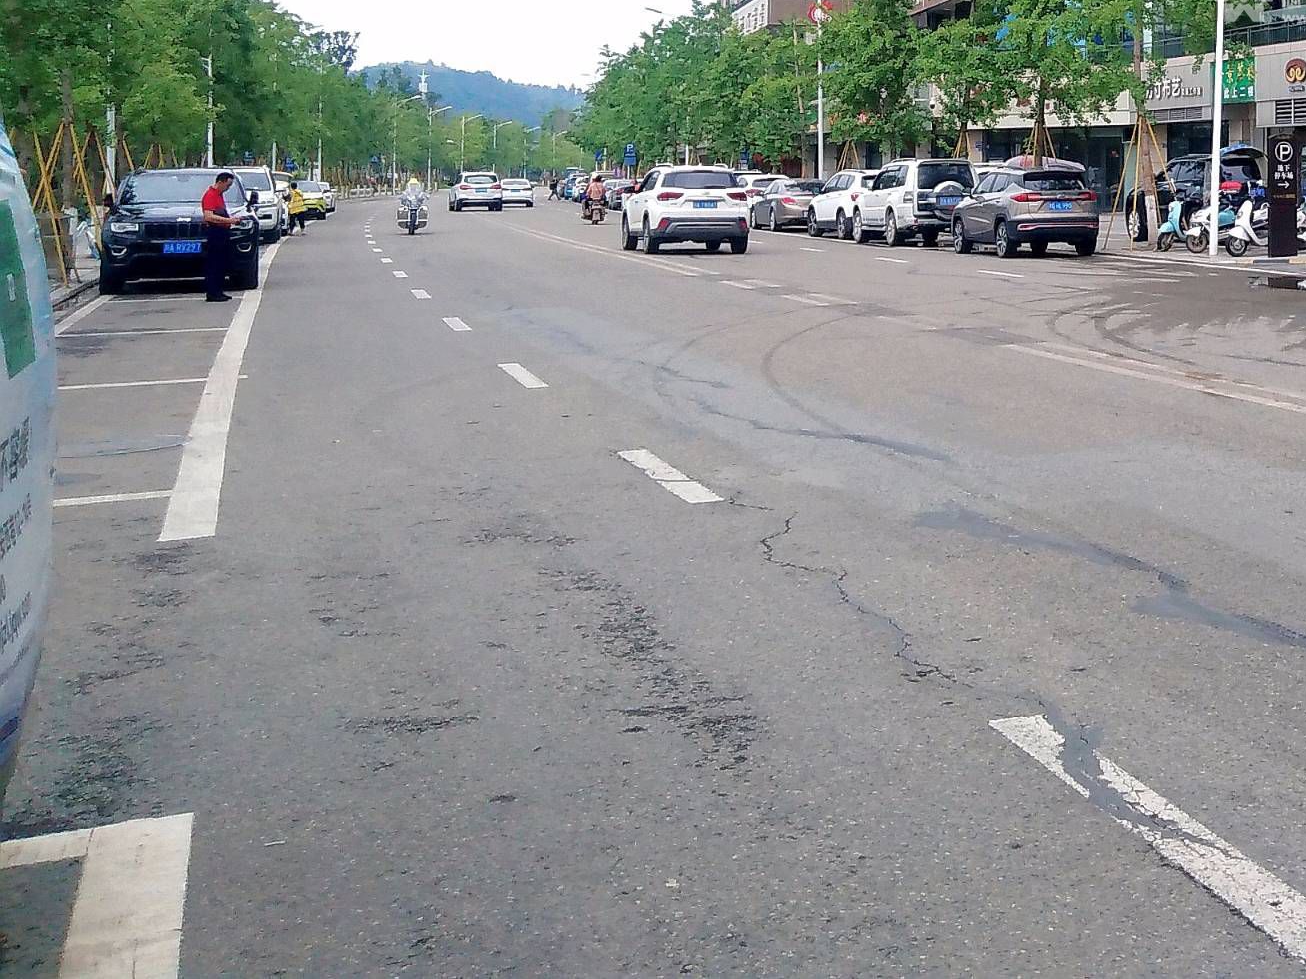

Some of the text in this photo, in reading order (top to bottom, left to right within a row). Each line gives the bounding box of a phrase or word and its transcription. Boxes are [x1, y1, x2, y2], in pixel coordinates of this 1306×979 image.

[1280, 144, 1290, 160] P
[1274, 172, 1294, 180] 停车场
